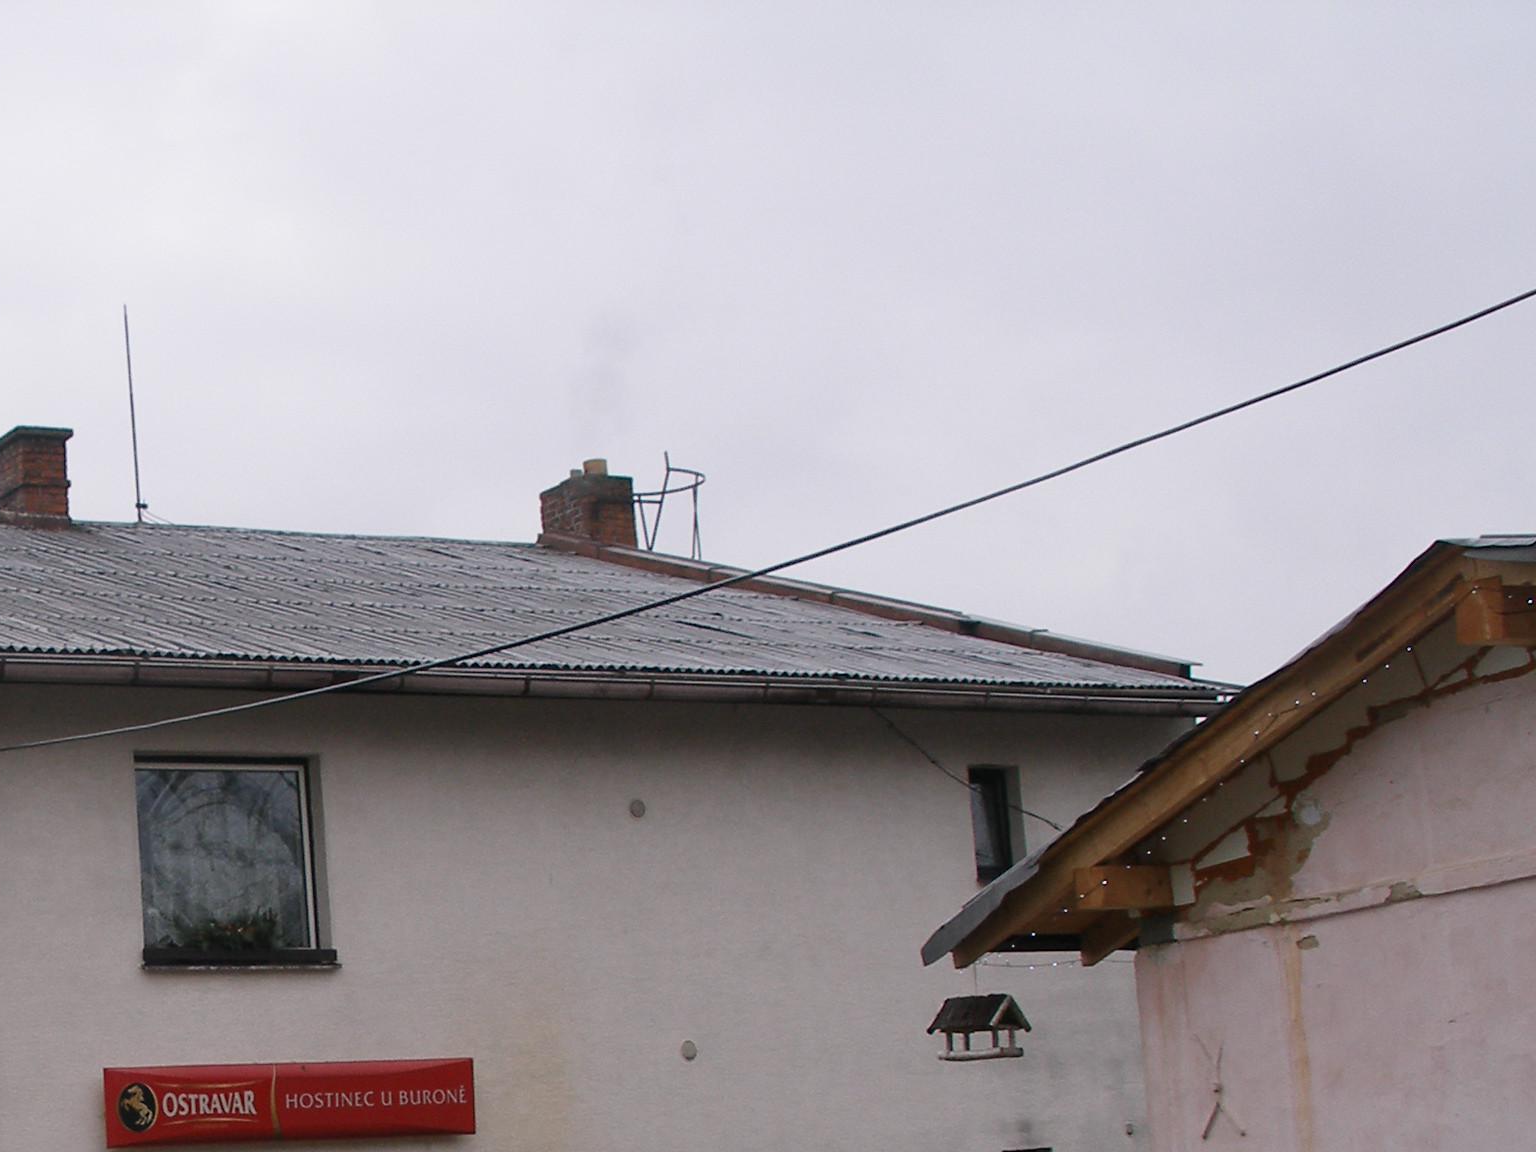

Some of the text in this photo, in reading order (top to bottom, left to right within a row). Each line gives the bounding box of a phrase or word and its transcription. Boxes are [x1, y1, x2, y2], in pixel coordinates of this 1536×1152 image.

[162, 1085, 468, 1117] OSTRAVAR HOSTINEC U BURONÉ
